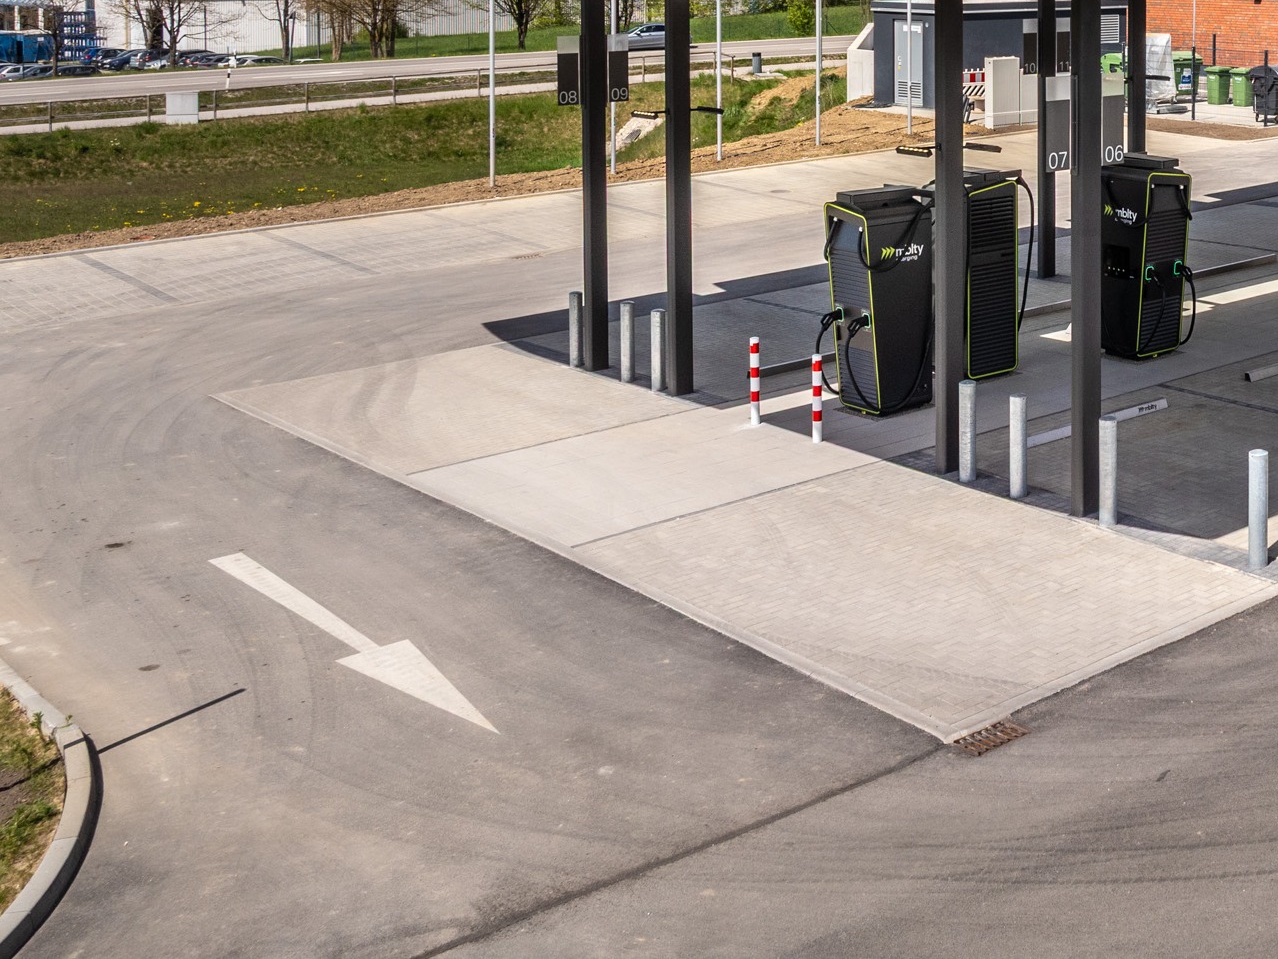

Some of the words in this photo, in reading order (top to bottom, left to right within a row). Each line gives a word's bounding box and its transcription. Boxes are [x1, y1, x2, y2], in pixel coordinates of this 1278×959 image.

[1024, 63, 1036, 73] 10
[1059, 61, 1070, 71] 11
[559, 90, 577, 104] 08
[611, 87, 628, 100] 09
[1048, 151, 1068, 170] 07
[1105, 145, 1124, 163] 06
